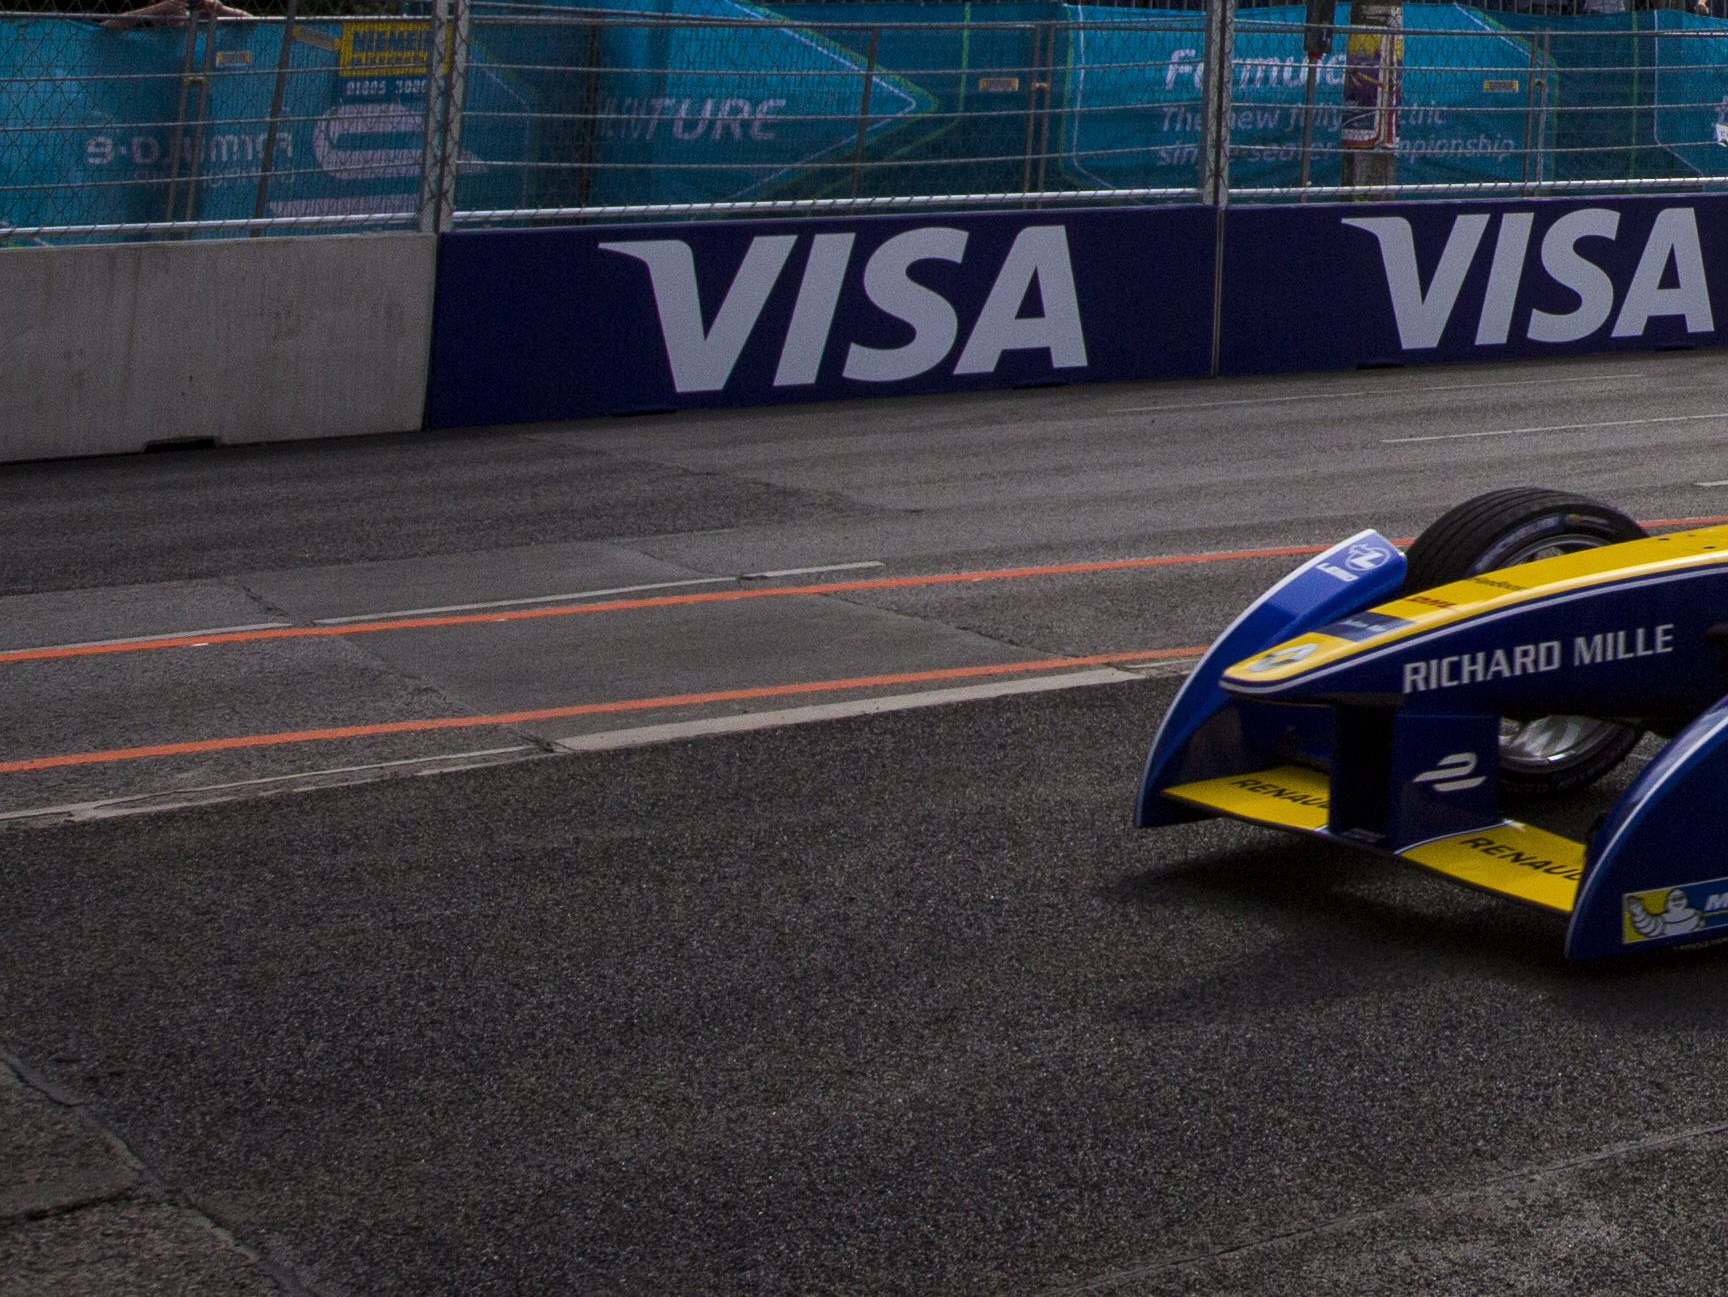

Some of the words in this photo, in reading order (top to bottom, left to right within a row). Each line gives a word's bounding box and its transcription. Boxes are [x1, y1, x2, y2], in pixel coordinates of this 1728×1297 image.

[599, 225, 1088, 393] VISA
[1340, 207, 1715, 350] VISA
[1402, 639, 1562, 695] RICHARD
[1573, 622, 1675, 667] MILLE
